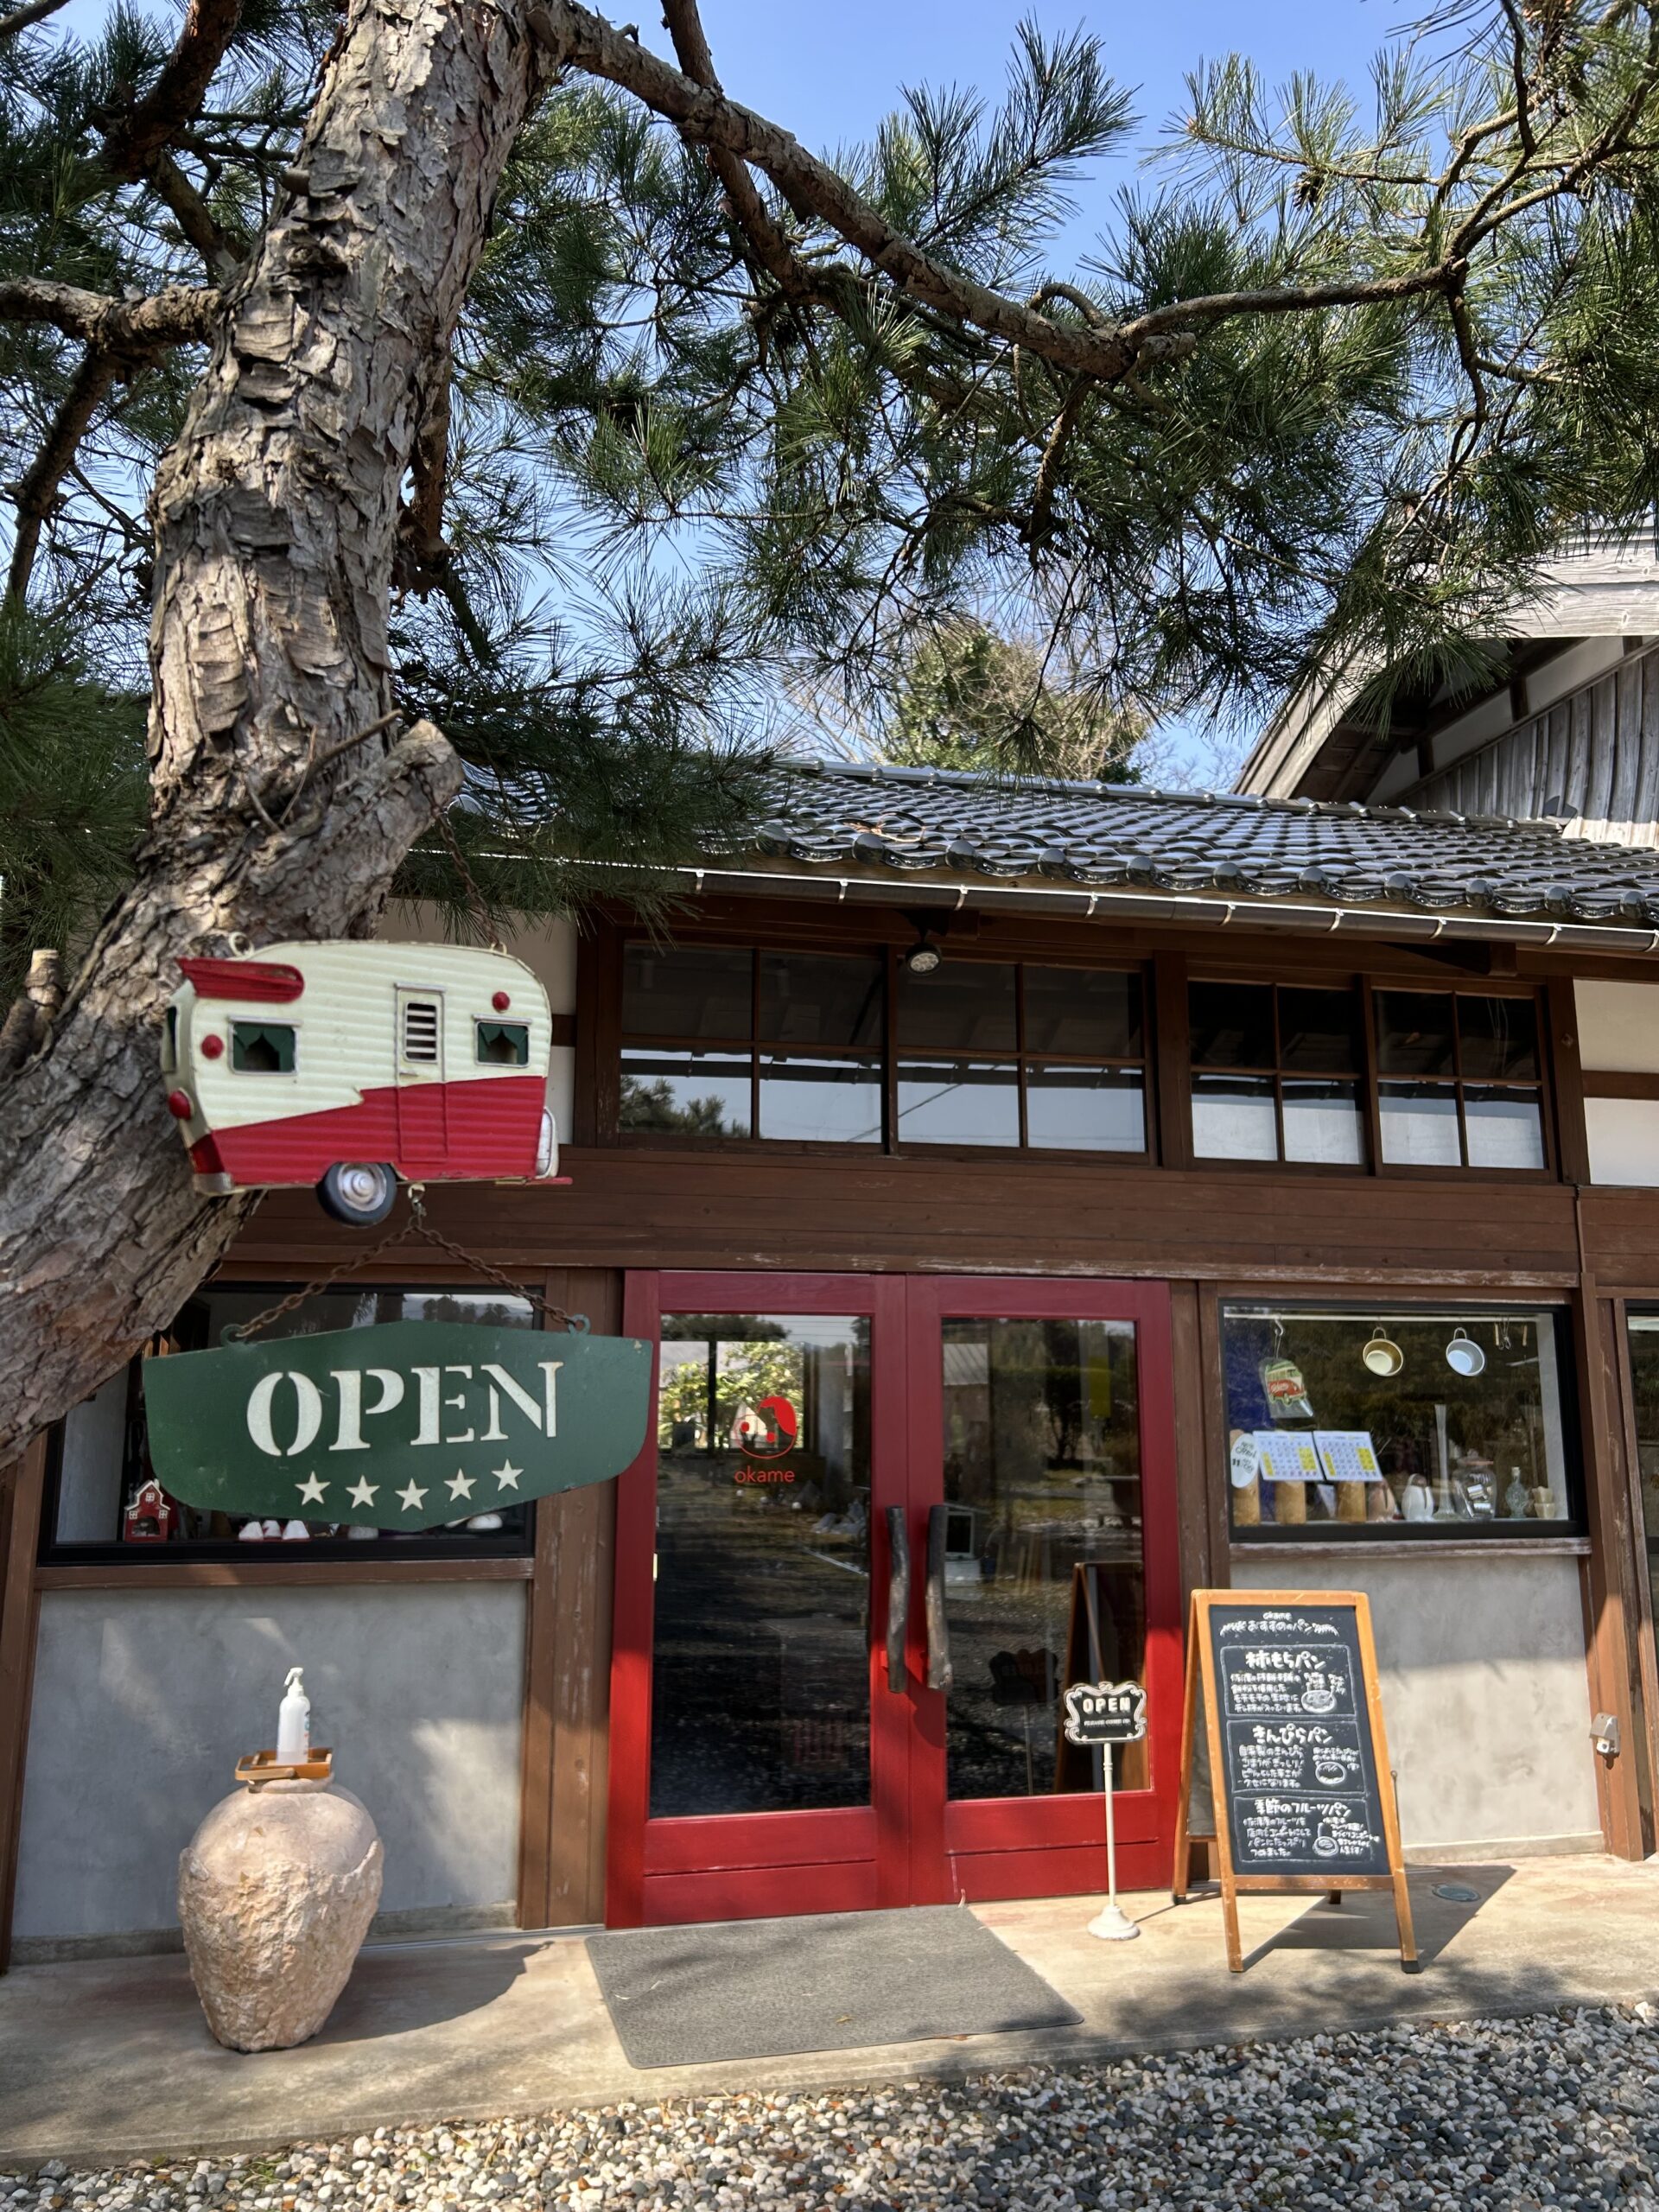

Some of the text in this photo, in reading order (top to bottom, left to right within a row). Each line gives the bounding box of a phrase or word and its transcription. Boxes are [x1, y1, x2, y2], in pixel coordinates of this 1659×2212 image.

[246, 1362, 563, 1456] OPEN
[734, 1465, 795, 1483] okame
[1245, 1649, 1327, 1670] 柿もちパン
[1083, 1696, 1131, 1714] OPEN
[1252, 1723, 1333, 1745] きんぴらパン
[1254, 1797, 1352, 1818] 季節のフルーツパン
